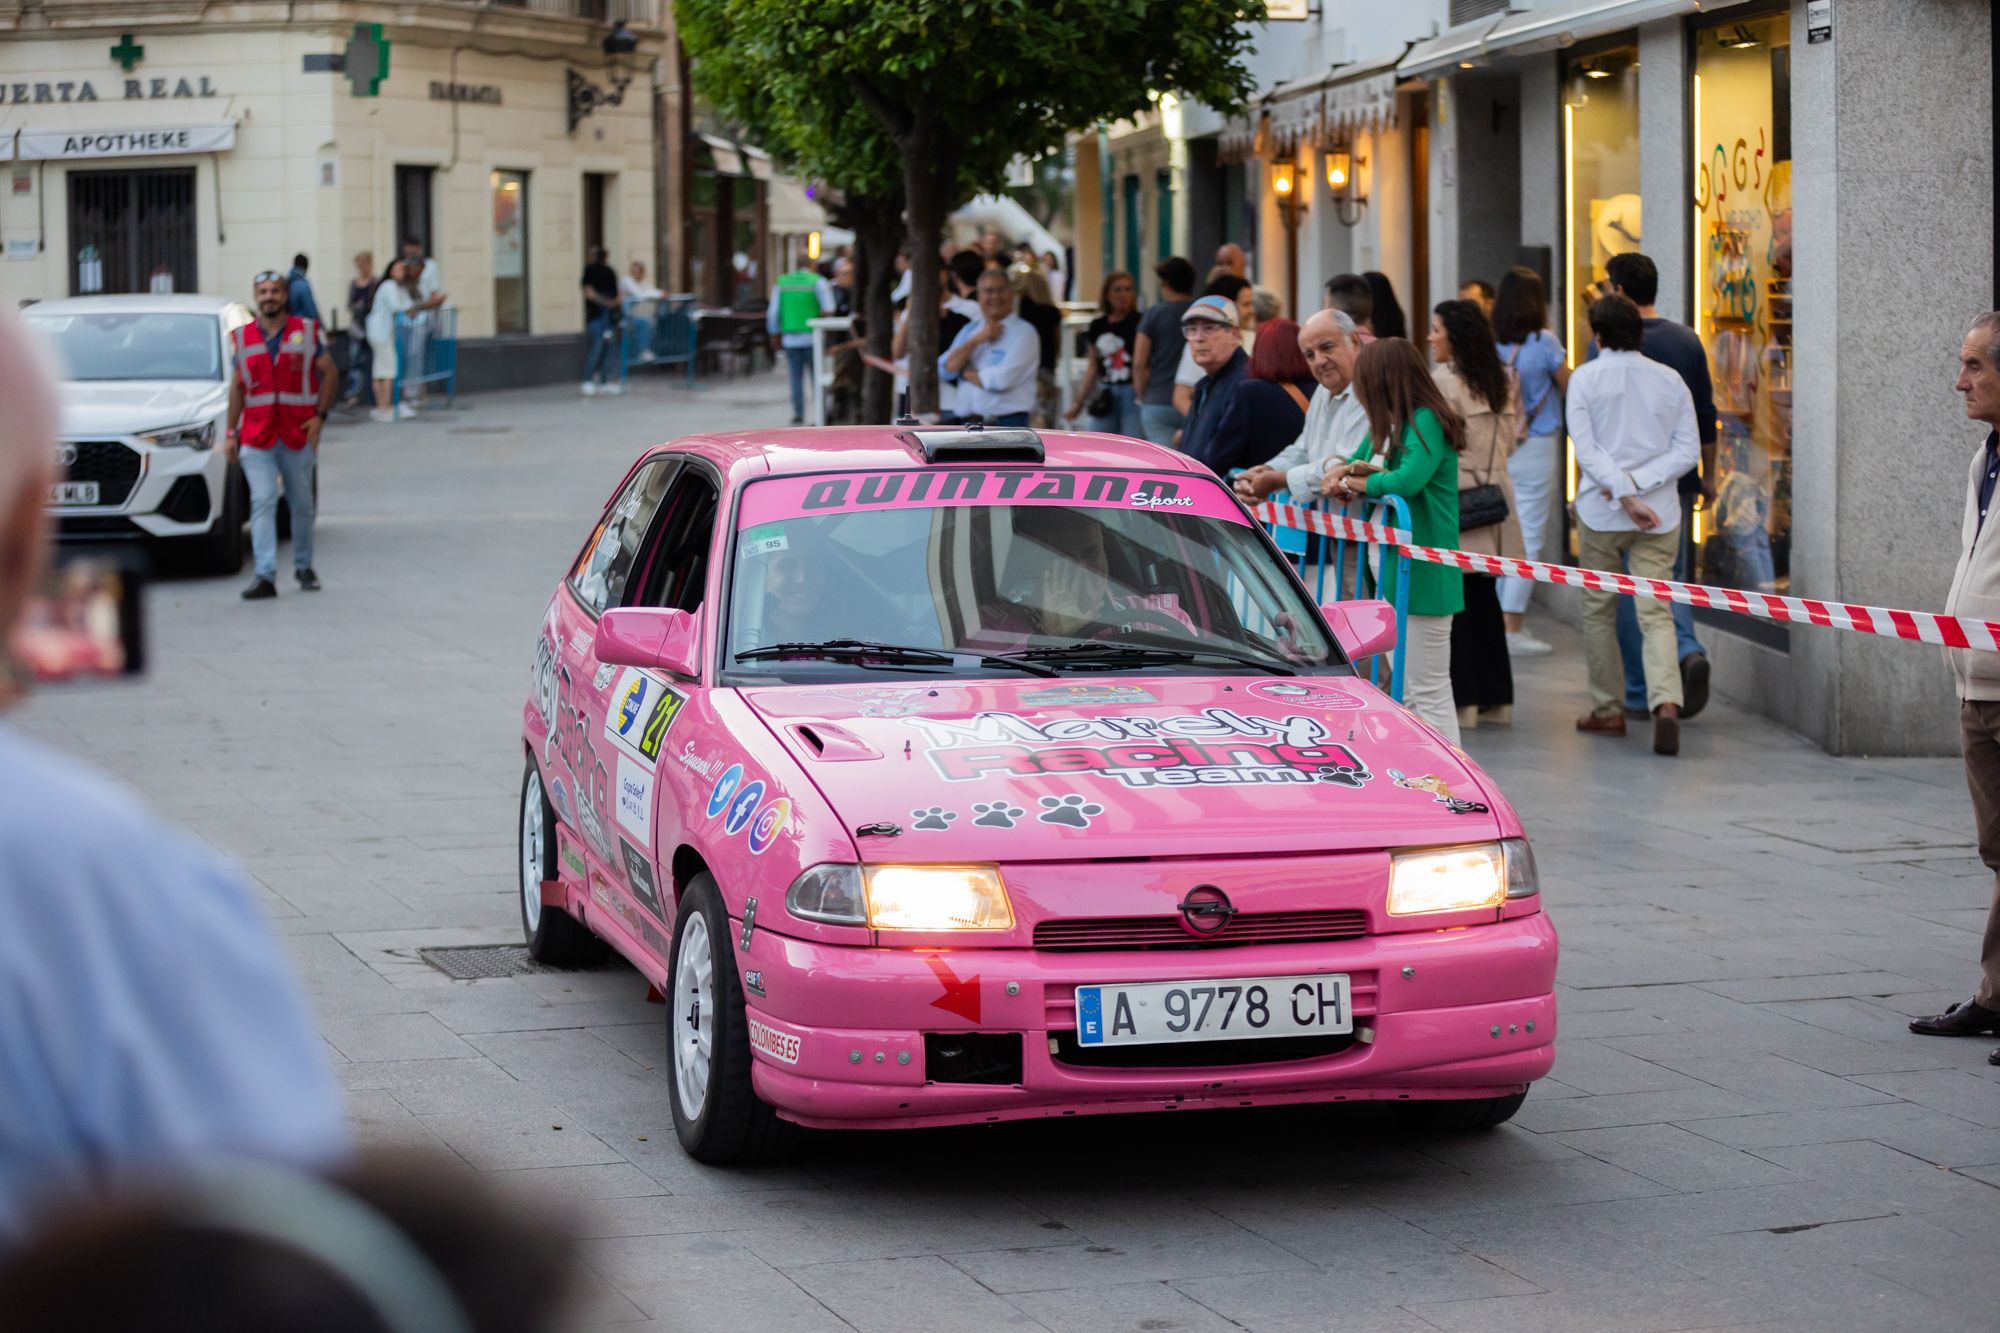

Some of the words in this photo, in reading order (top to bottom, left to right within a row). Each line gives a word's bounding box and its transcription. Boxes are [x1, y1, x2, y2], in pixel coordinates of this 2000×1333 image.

[124, 77, 217, 99] REAL
[64, 129, 191, 154] APOTHEKE
[800, 471, 1179, 510] QUINTANO
[1129, 491, 1194, 510] Sport
[765, 540, 781, 549] 95
[641, 693, 680, 757] 21
[900, 709, 1328, 748] Marely
[930, 737, 1364, 780] Racing
[1105, 766, 1319, 786] Team
[1086, 1021, 1097, 1034] E
[1112, 992, 1137, 1036] A
[1165, 986, 1270, 1033] 9778
[1292, 982, 1342, 1026] CH
